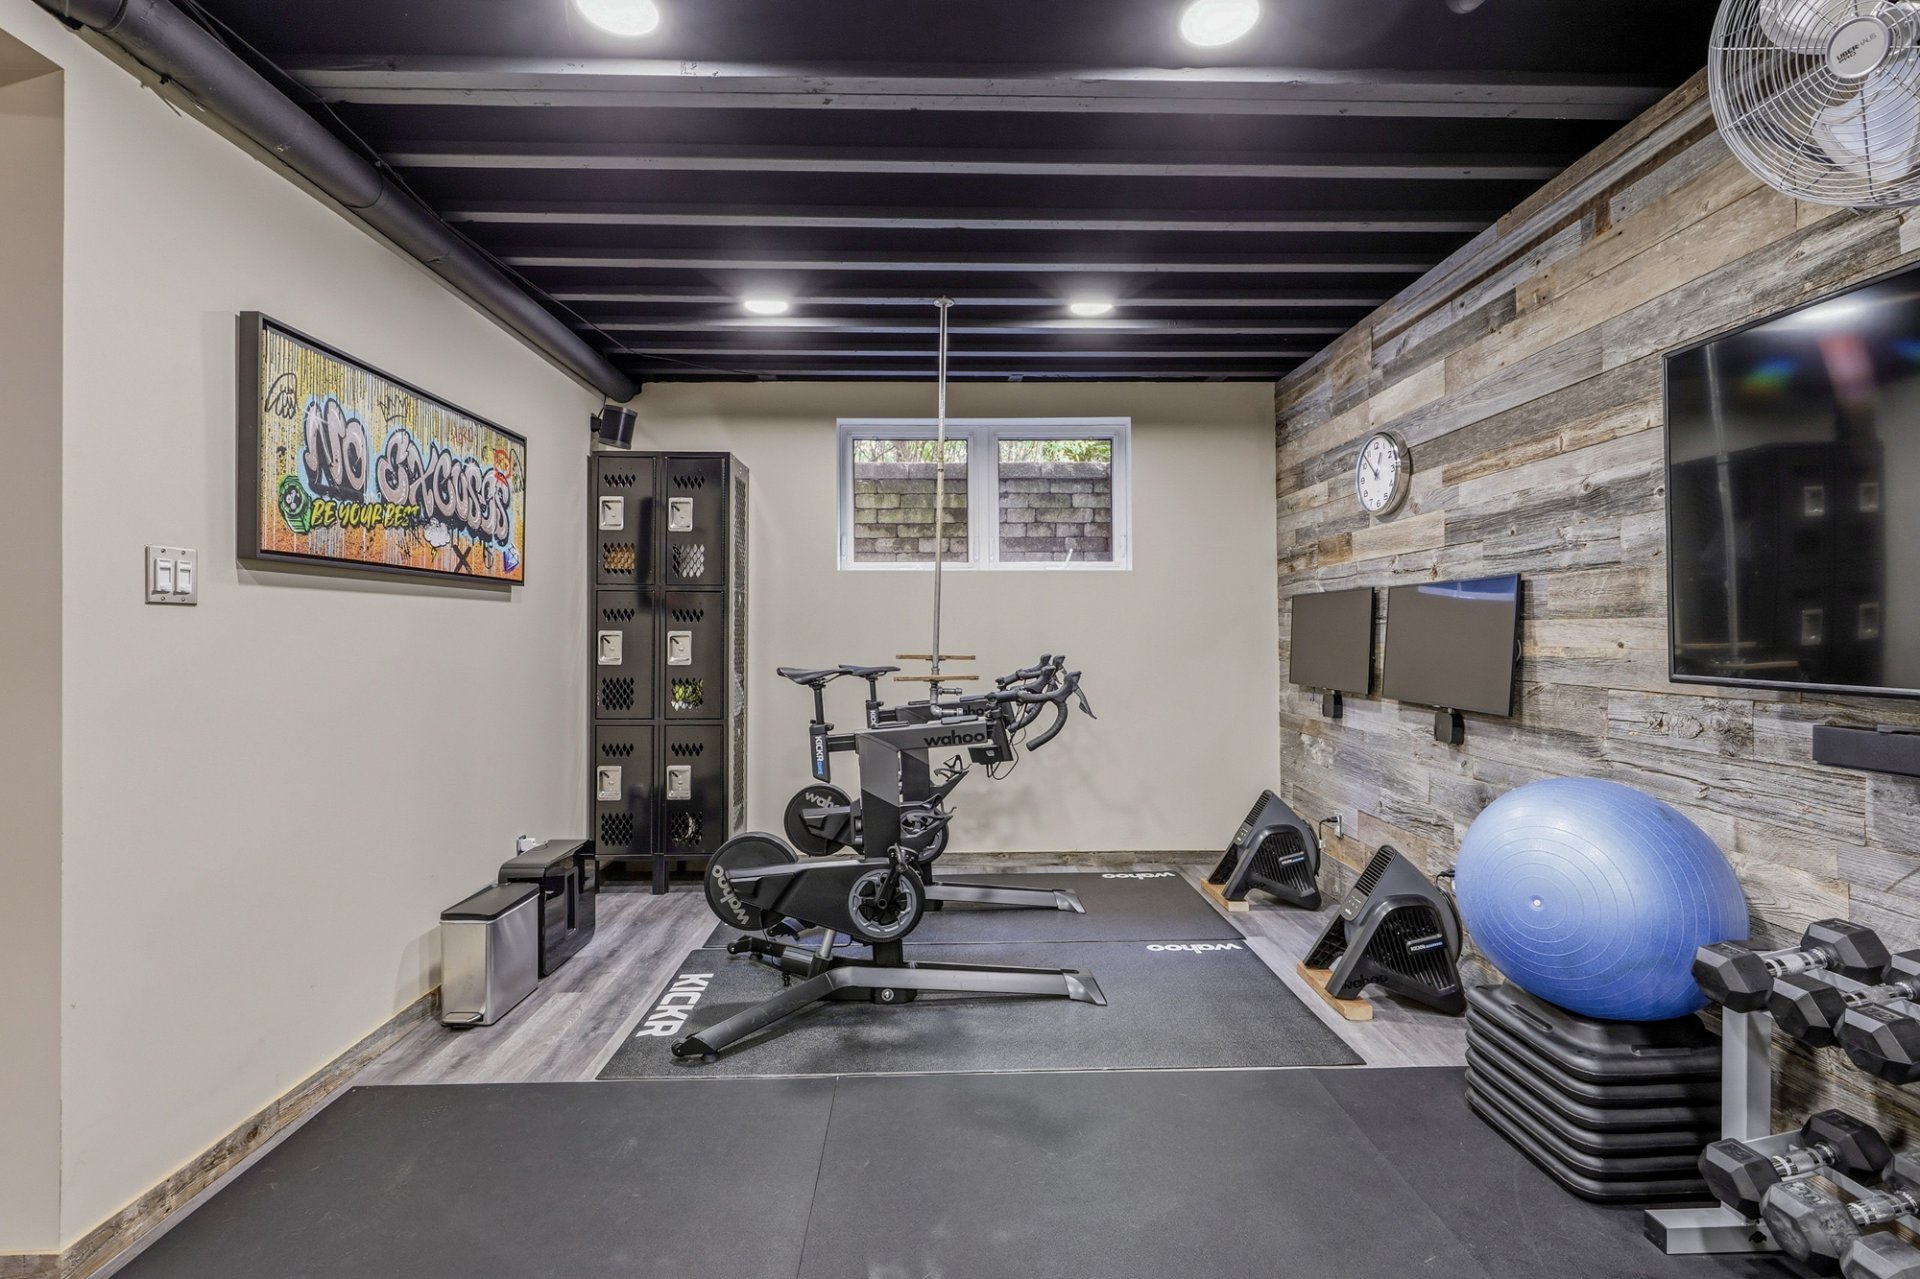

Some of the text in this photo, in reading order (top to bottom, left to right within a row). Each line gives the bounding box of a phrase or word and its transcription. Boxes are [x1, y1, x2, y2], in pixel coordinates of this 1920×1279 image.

[1387, 450, 1393, 459] 2
[303, 398, 512, 547] NO EXCUSES
[1390, 464, 1396, 473] 3
[1360, 476, 1366, 485] 9
[1363, 489, 1369, 498] 8
[1383, 492, 1389, 501] 5
[1369, 498, 1374, 507] 7
[1376, 499, 1382, 508] 6
[310, 499, 421, 532] BE YOUR BEST
[923, 729, 985, 747] wahoo
[814, 735, 824, 763] KICKR
[1101, 871, 1176, 880] wahoo
[711, 864, 750, 926] wahoo
[1146, 942, 1243, 954] wahoo
[635, 972, 715, 1038] KICKR
